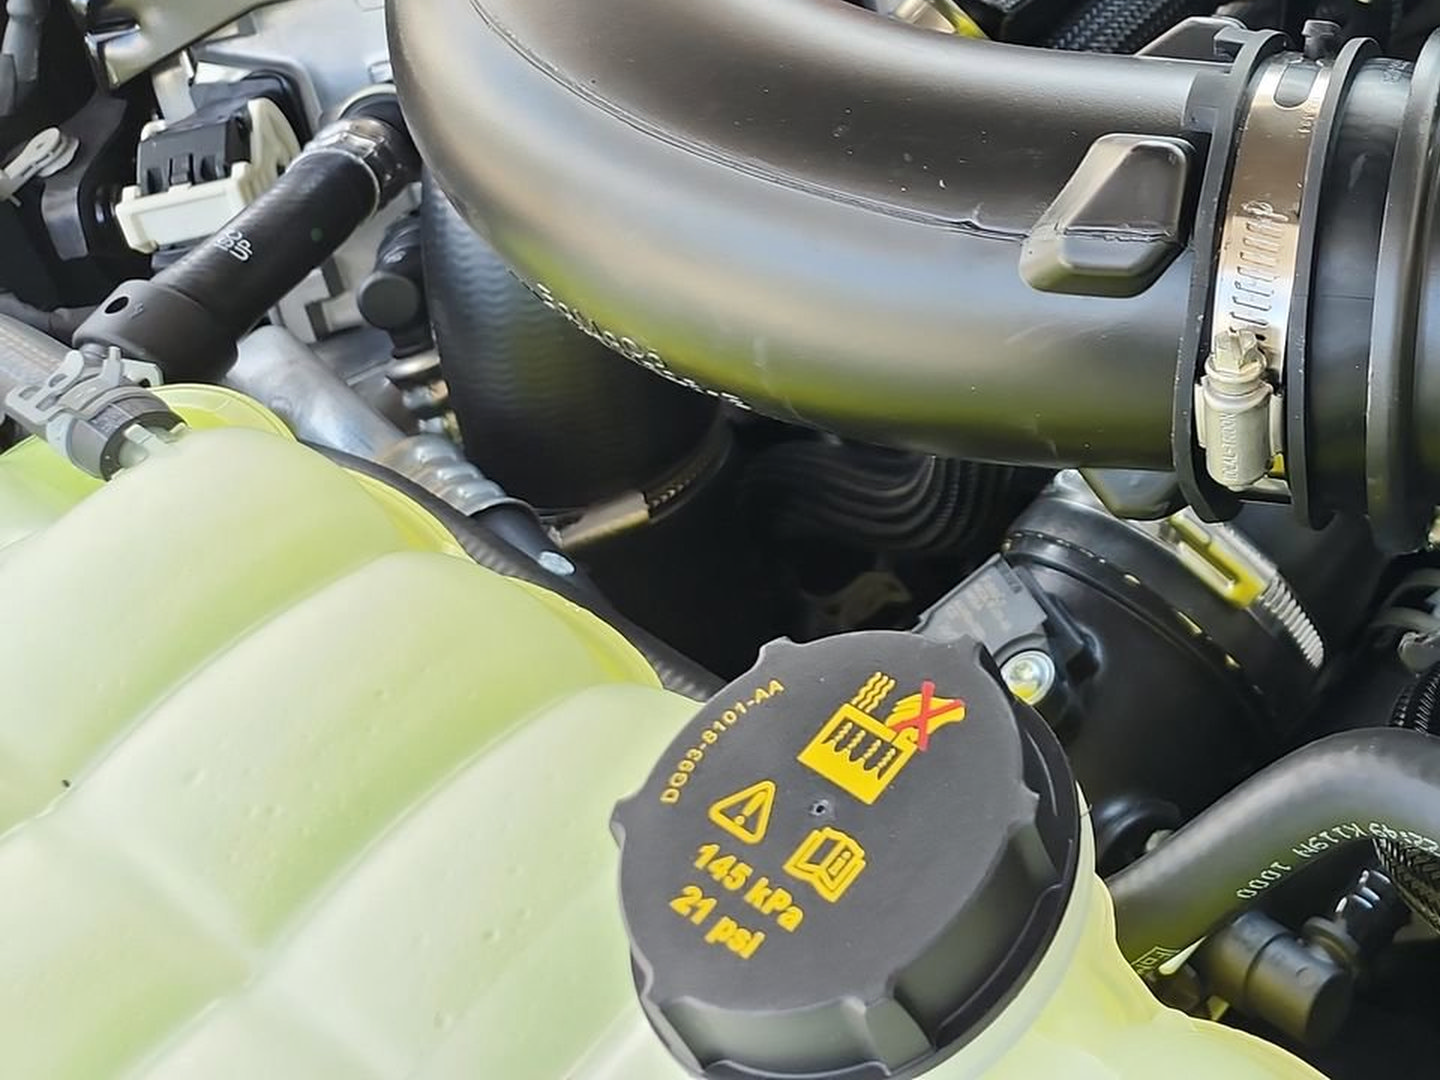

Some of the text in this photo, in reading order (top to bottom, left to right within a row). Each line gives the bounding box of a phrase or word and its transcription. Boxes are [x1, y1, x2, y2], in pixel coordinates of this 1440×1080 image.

[228, 238, 254, 262] UP
[659, 678, 785, 804] DG93-8101-AA
[695, 843, 805, 932] 145 kPa
[1236, 860, 1293, 900] 1000
[669, 885, 767, 959] 21 psi
